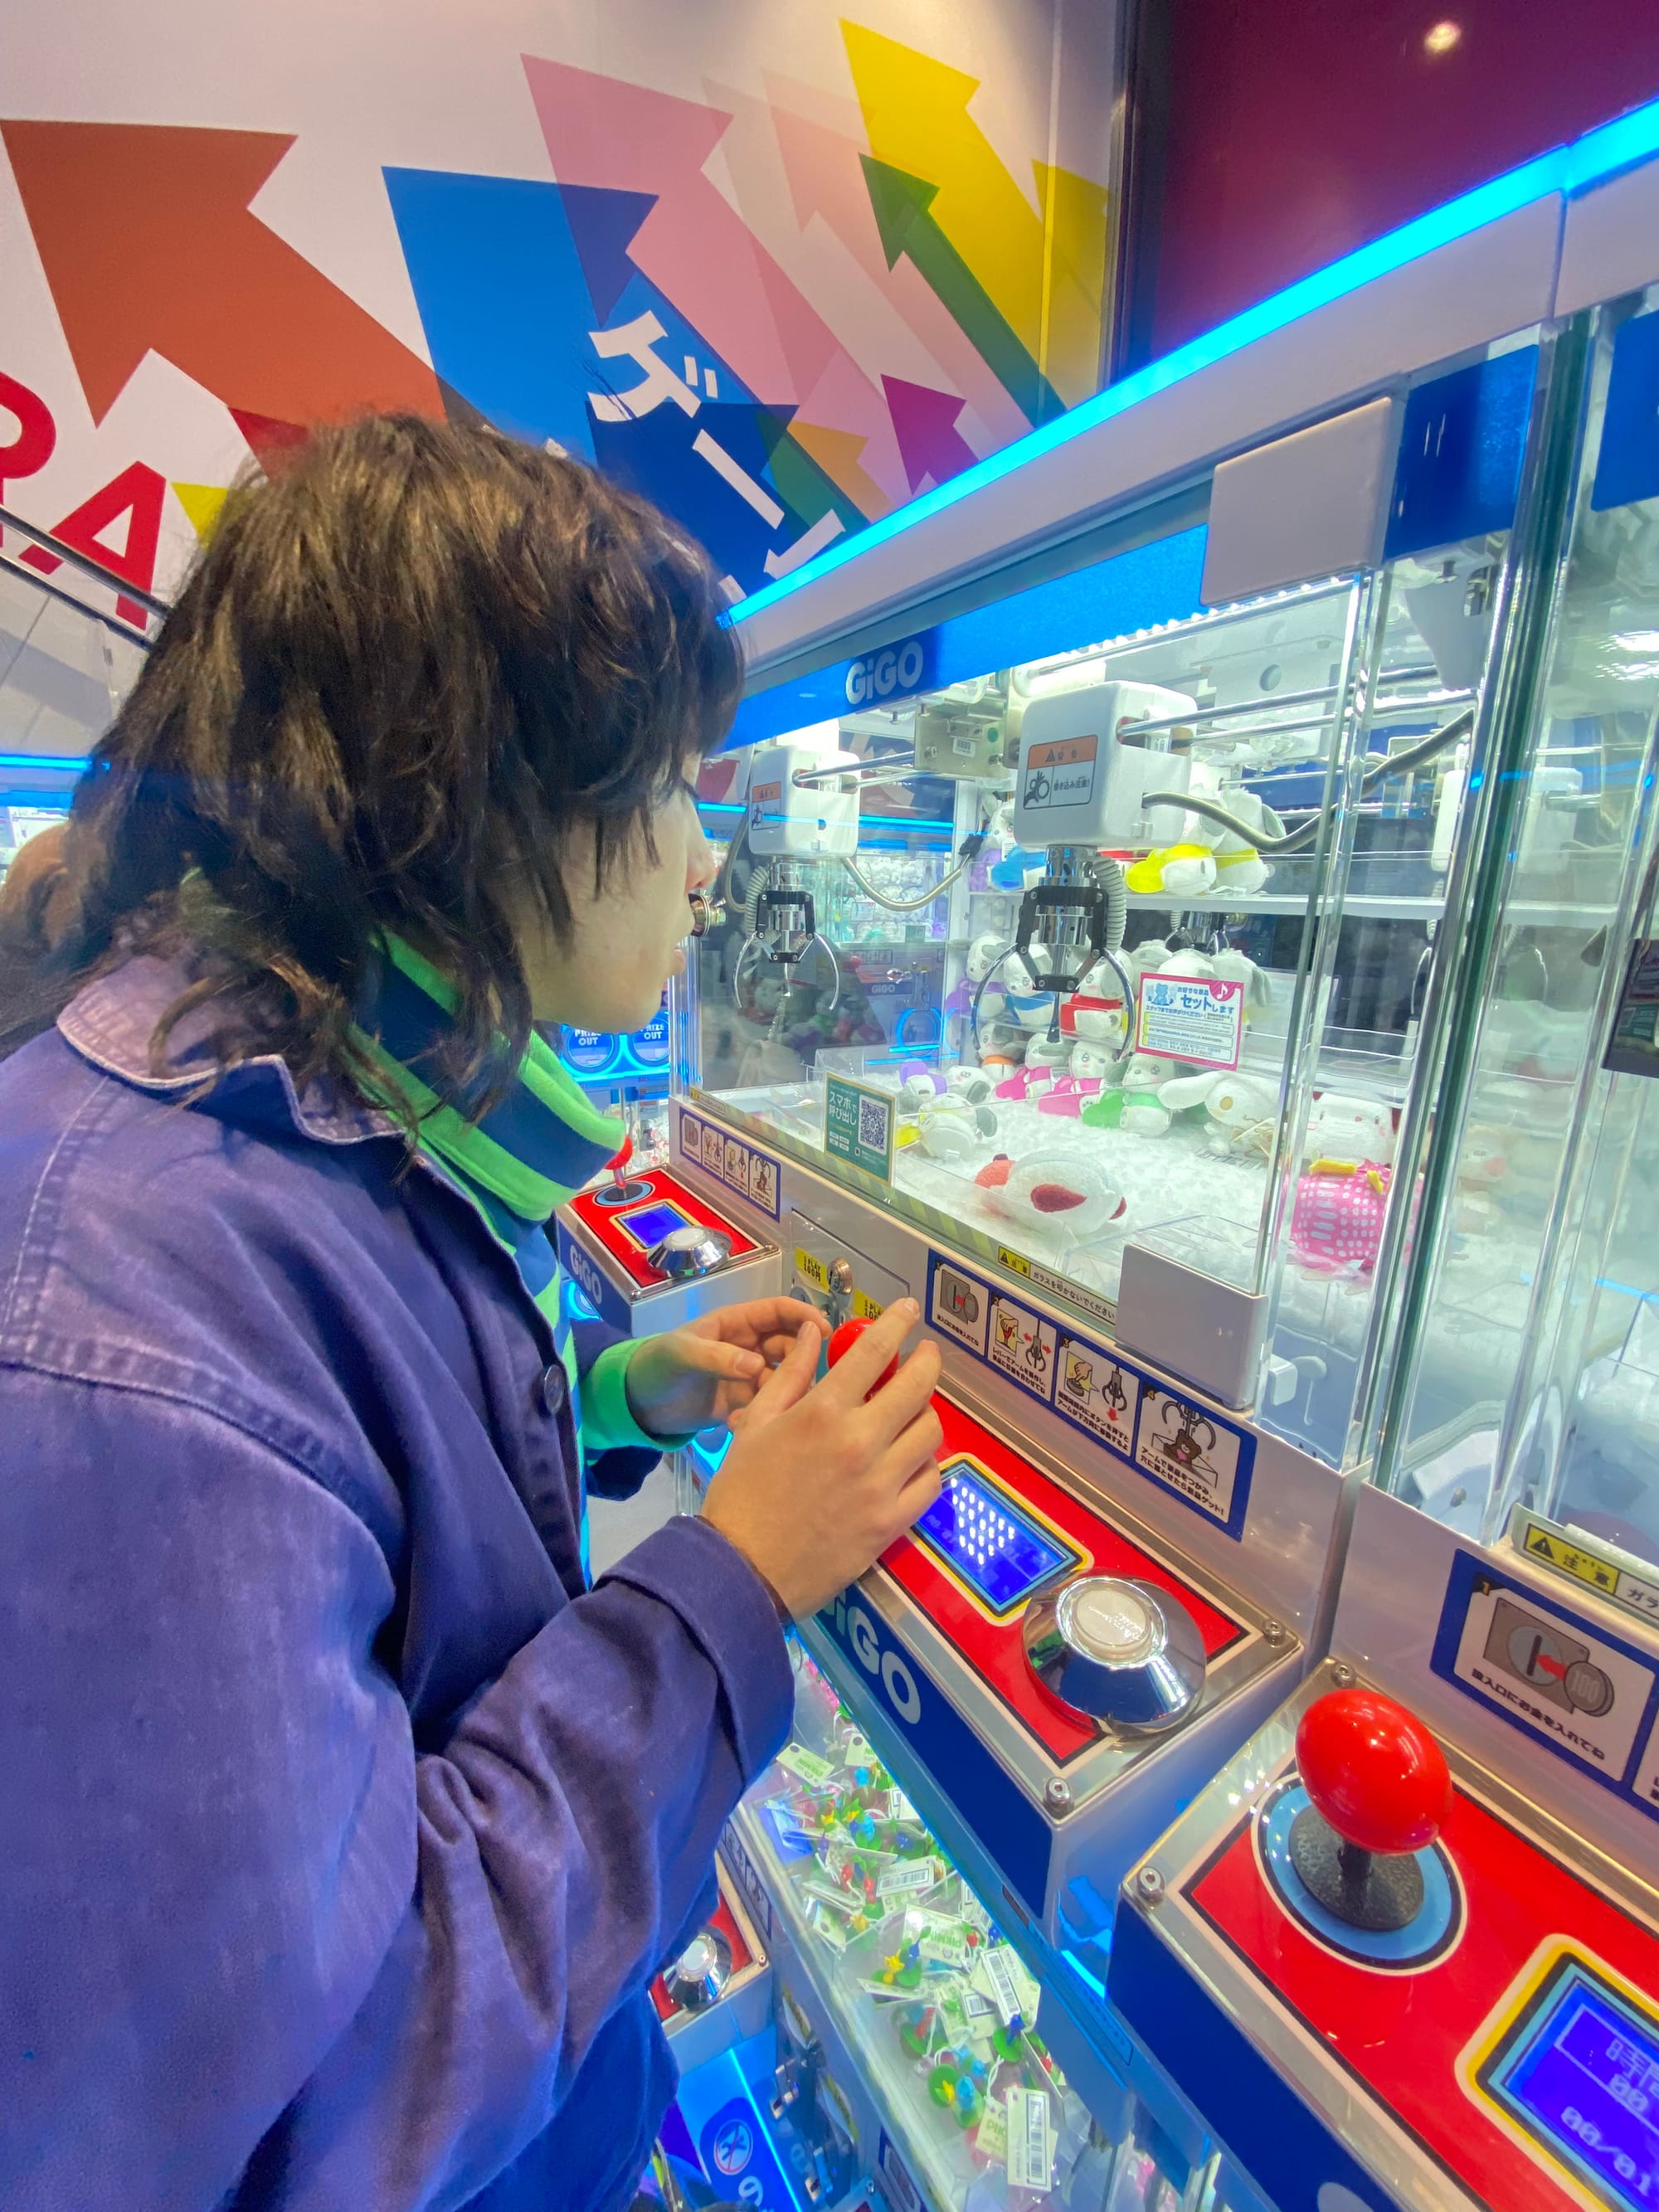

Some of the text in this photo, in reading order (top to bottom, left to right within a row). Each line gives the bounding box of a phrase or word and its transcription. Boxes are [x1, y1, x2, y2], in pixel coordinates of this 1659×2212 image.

[845, 640, 924, 705] GiGO
[1180, 994, 1235, 1014] セットします
[578, 1038, 599, 1046] OUT
[644, 1032, 663, 1040] OUT
[830, 1091, 857, 1113] スマホで
[829, 1105, 857, 1125] 呼び出し
[570, 1245, 602, 1305] GiGO
[1034, 1271, 1116, 1319] ガラスを叩かないでください
[1063, 1338, 1070, 1349] 3
[1147, 1389, 1155, 1401] 4
[1563, 1554, 1610, 1587] 注意
[1481, 1581, 1491, 1597] 1
[820, 1591, 922, 1725] iGO
[1560, 2105, 1652, 2197] 00/01
